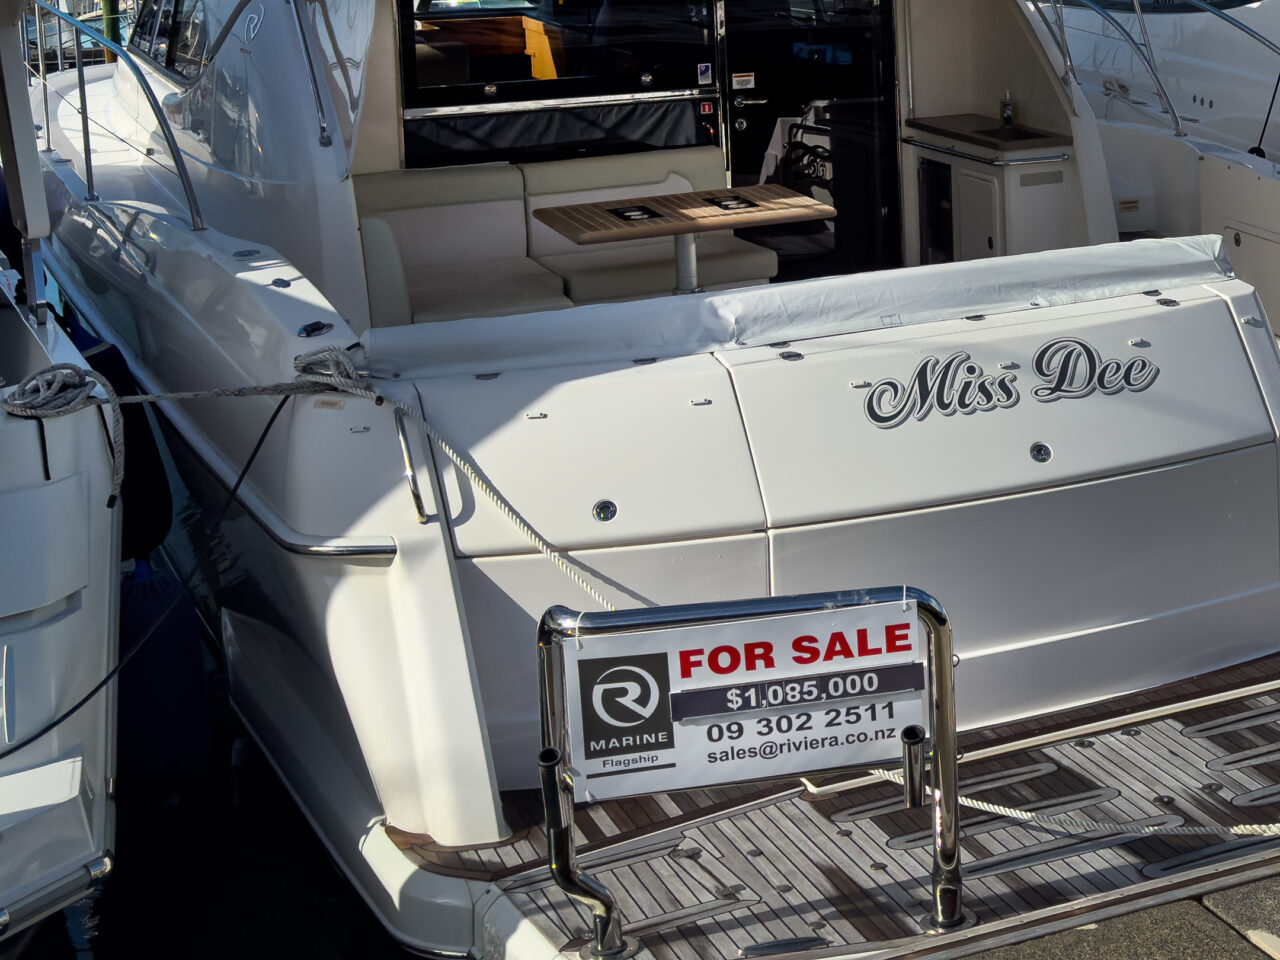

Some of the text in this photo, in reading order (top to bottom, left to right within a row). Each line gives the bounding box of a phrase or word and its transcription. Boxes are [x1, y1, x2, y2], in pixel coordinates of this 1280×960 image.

[864, 336, 1160, 430] Miss Dee
[678, 622, 912, 679] FOR SALE
[726, 672, 879, 711] $1,085,000
[589, 731, 668, 752] MARINE
[706, 701, 896, 743] 09 302 2511
[602, 753, 659, 769] Flagship
[707, 726, 897, 764] sales@riviera.co.nz
